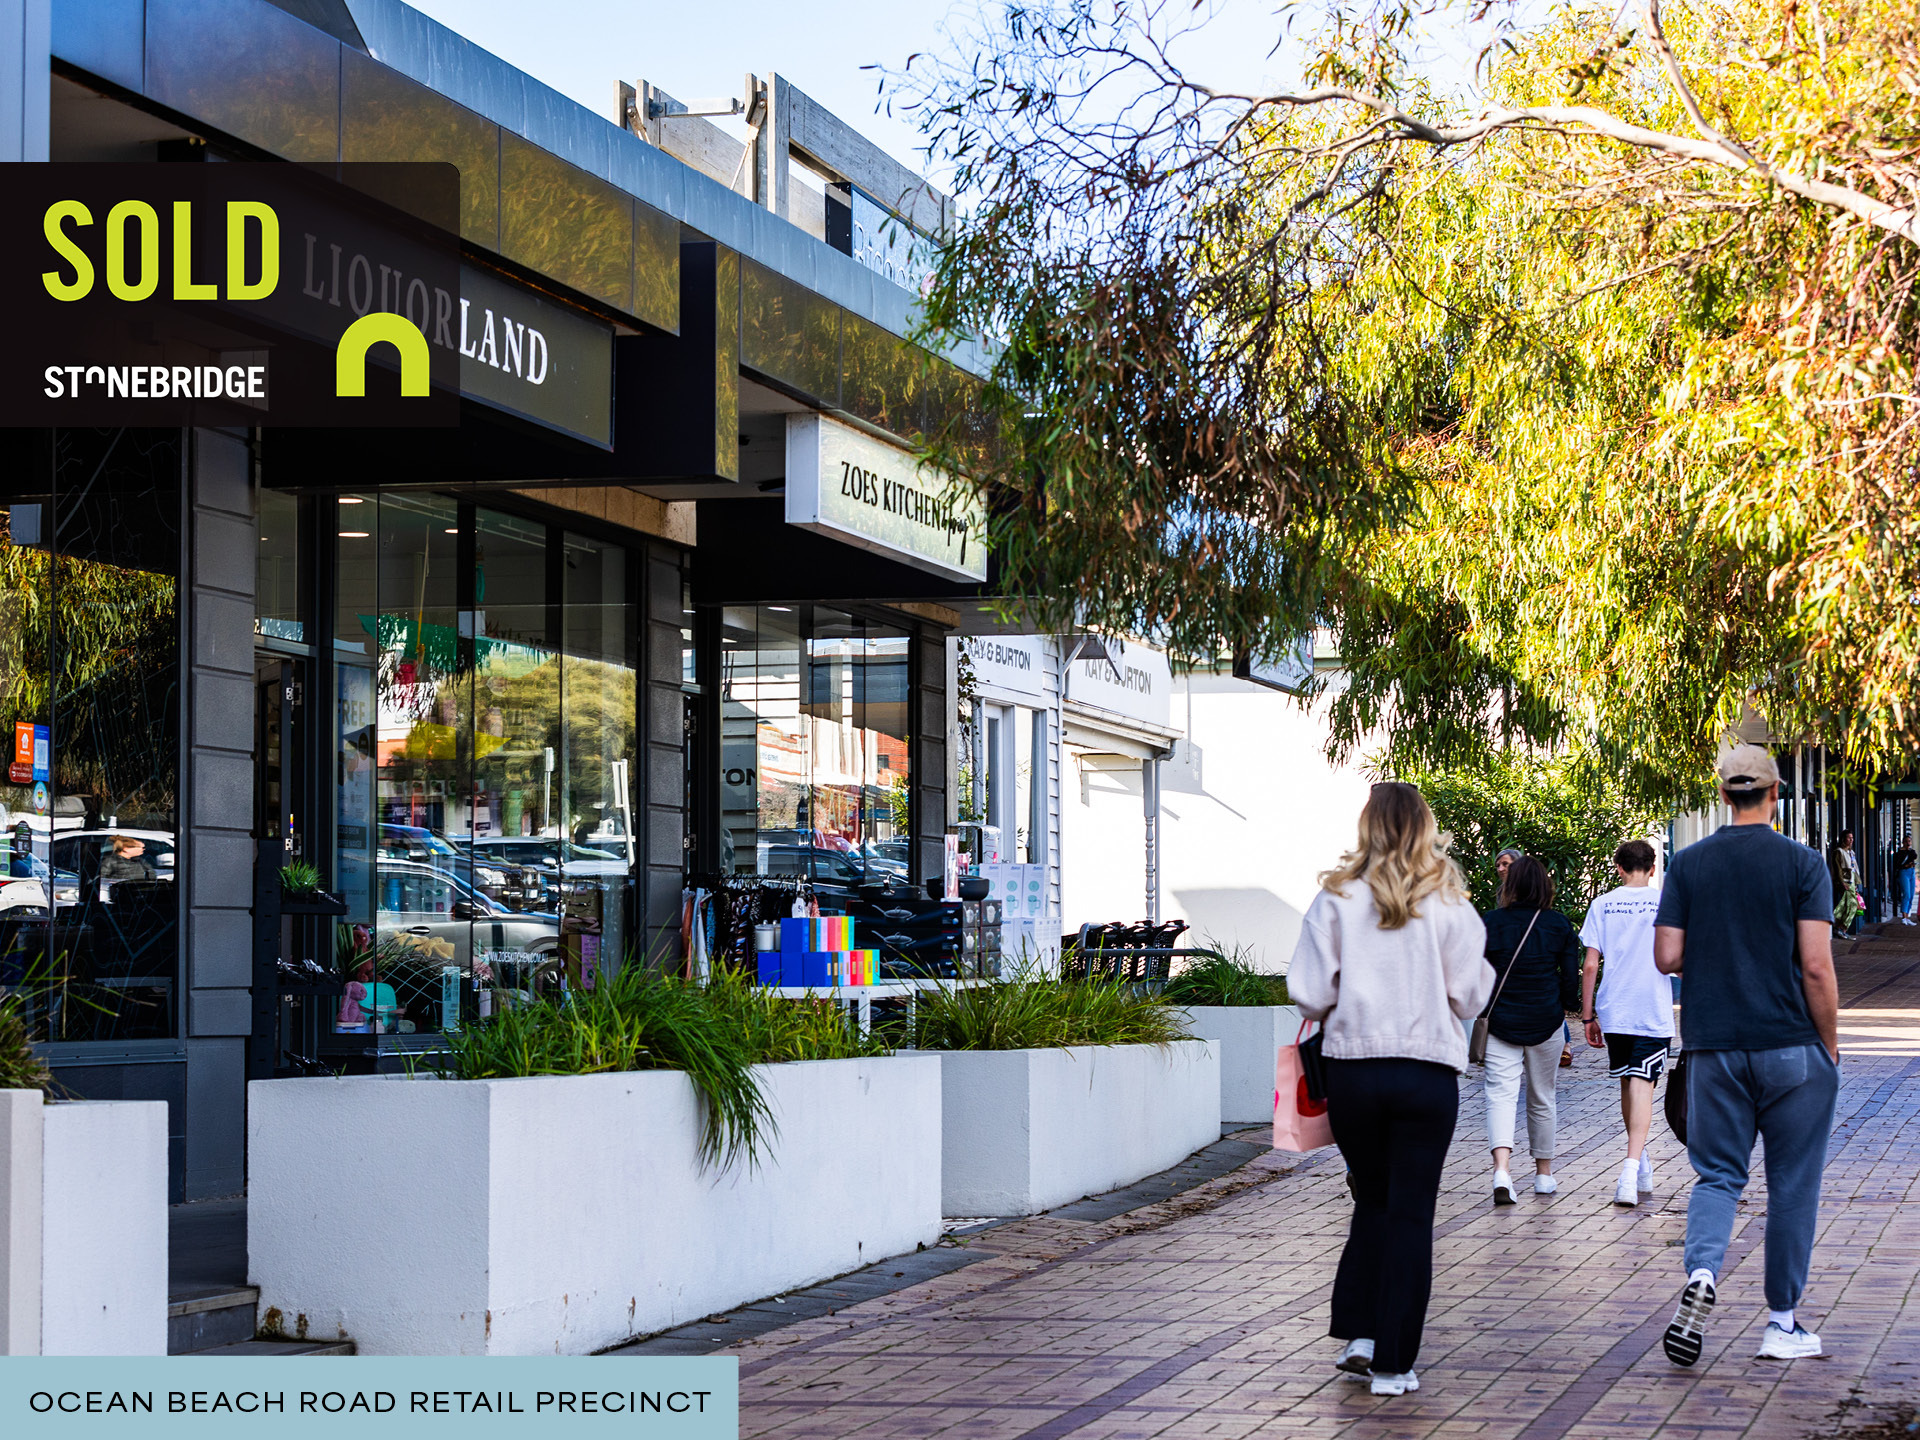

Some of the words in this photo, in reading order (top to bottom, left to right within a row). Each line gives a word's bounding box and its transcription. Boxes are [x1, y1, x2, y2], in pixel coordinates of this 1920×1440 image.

[302, 232, 549, 385] LIQUORLAND
[841, 460, 878, 507] ZOES
[883, 477, 941, 531] KITCHEN
[986, 642, 994, 662] &
[995, 644, 1031, 671] BURTON
[1085, 658, 1104, 681] KAY
[1104, 659, 1113, 683] &
[1113, 665, 1152, 696] URTON
[723, 768, 756, 787] ON
